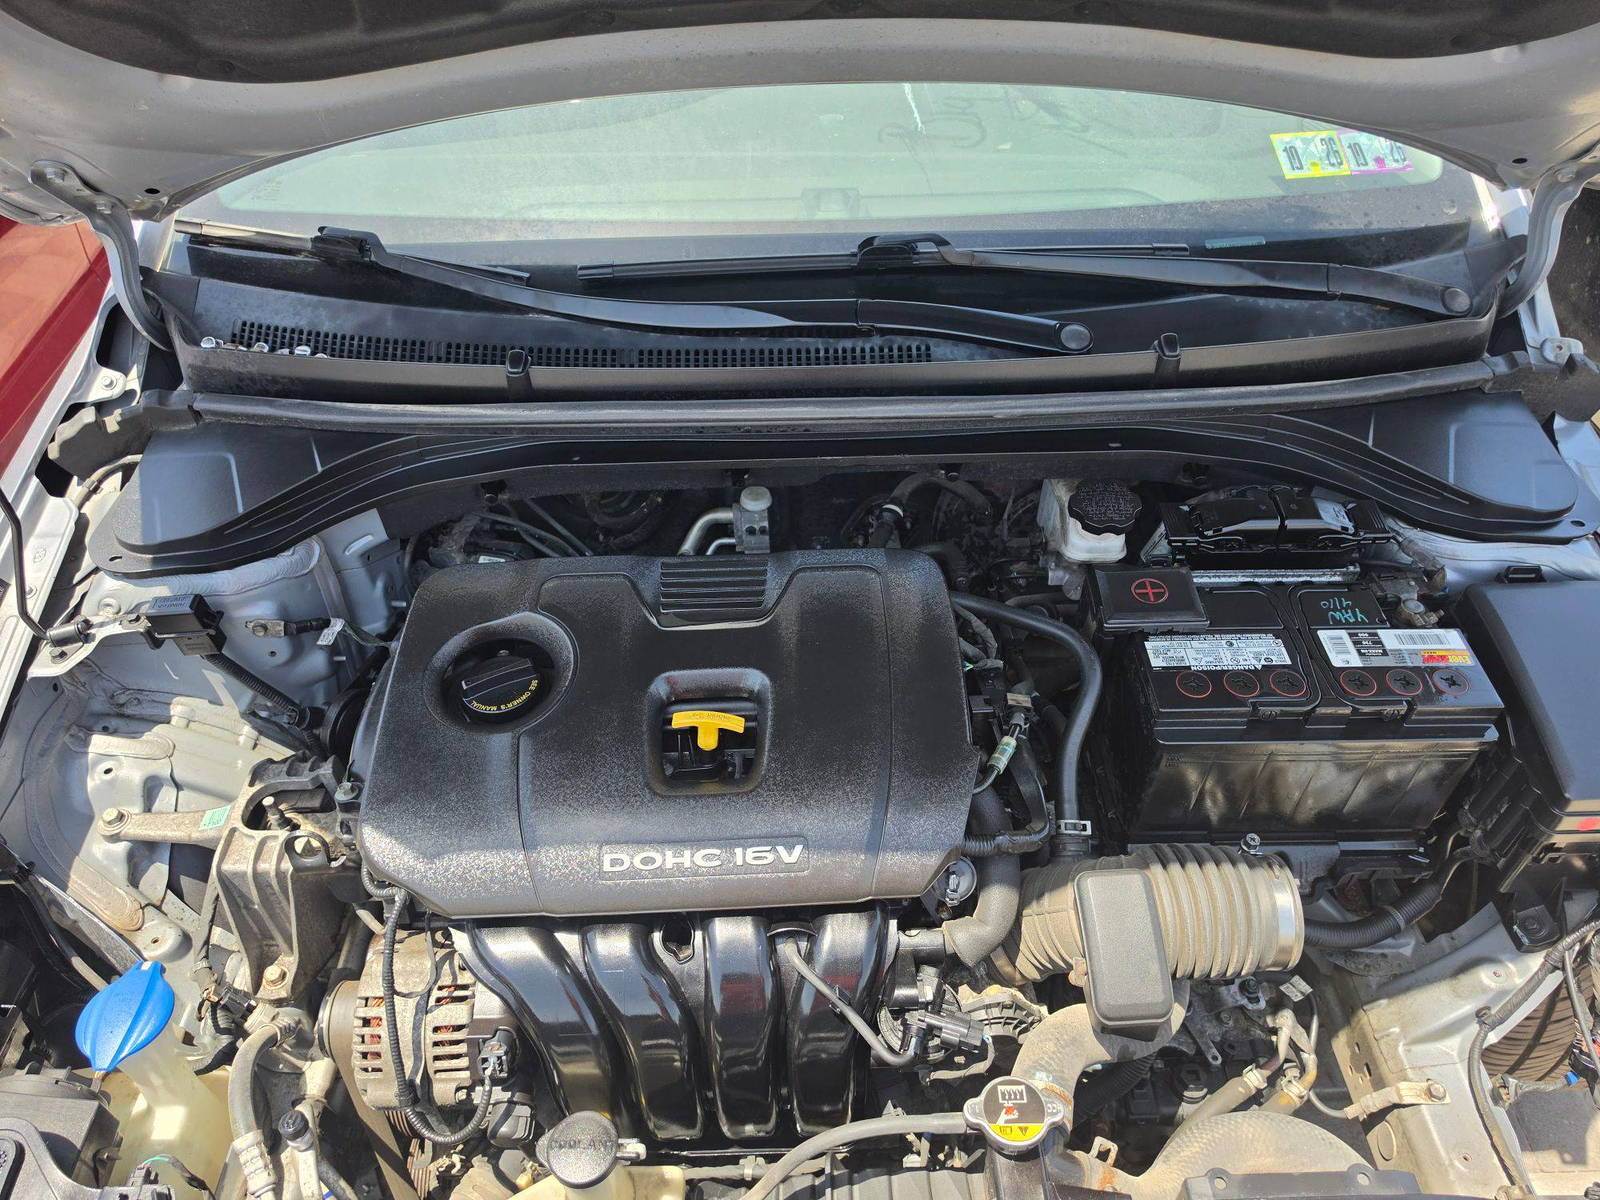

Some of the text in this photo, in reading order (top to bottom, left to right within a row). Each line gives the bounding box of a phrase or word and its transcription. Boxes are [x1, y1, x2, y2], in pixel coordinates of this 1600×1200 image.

[1319, 137, 1344, 168] 26
[470, 679, 539, 711] SEE OWNER'S MANUAL
[603, 844, 804, 872] DOHC 16V
